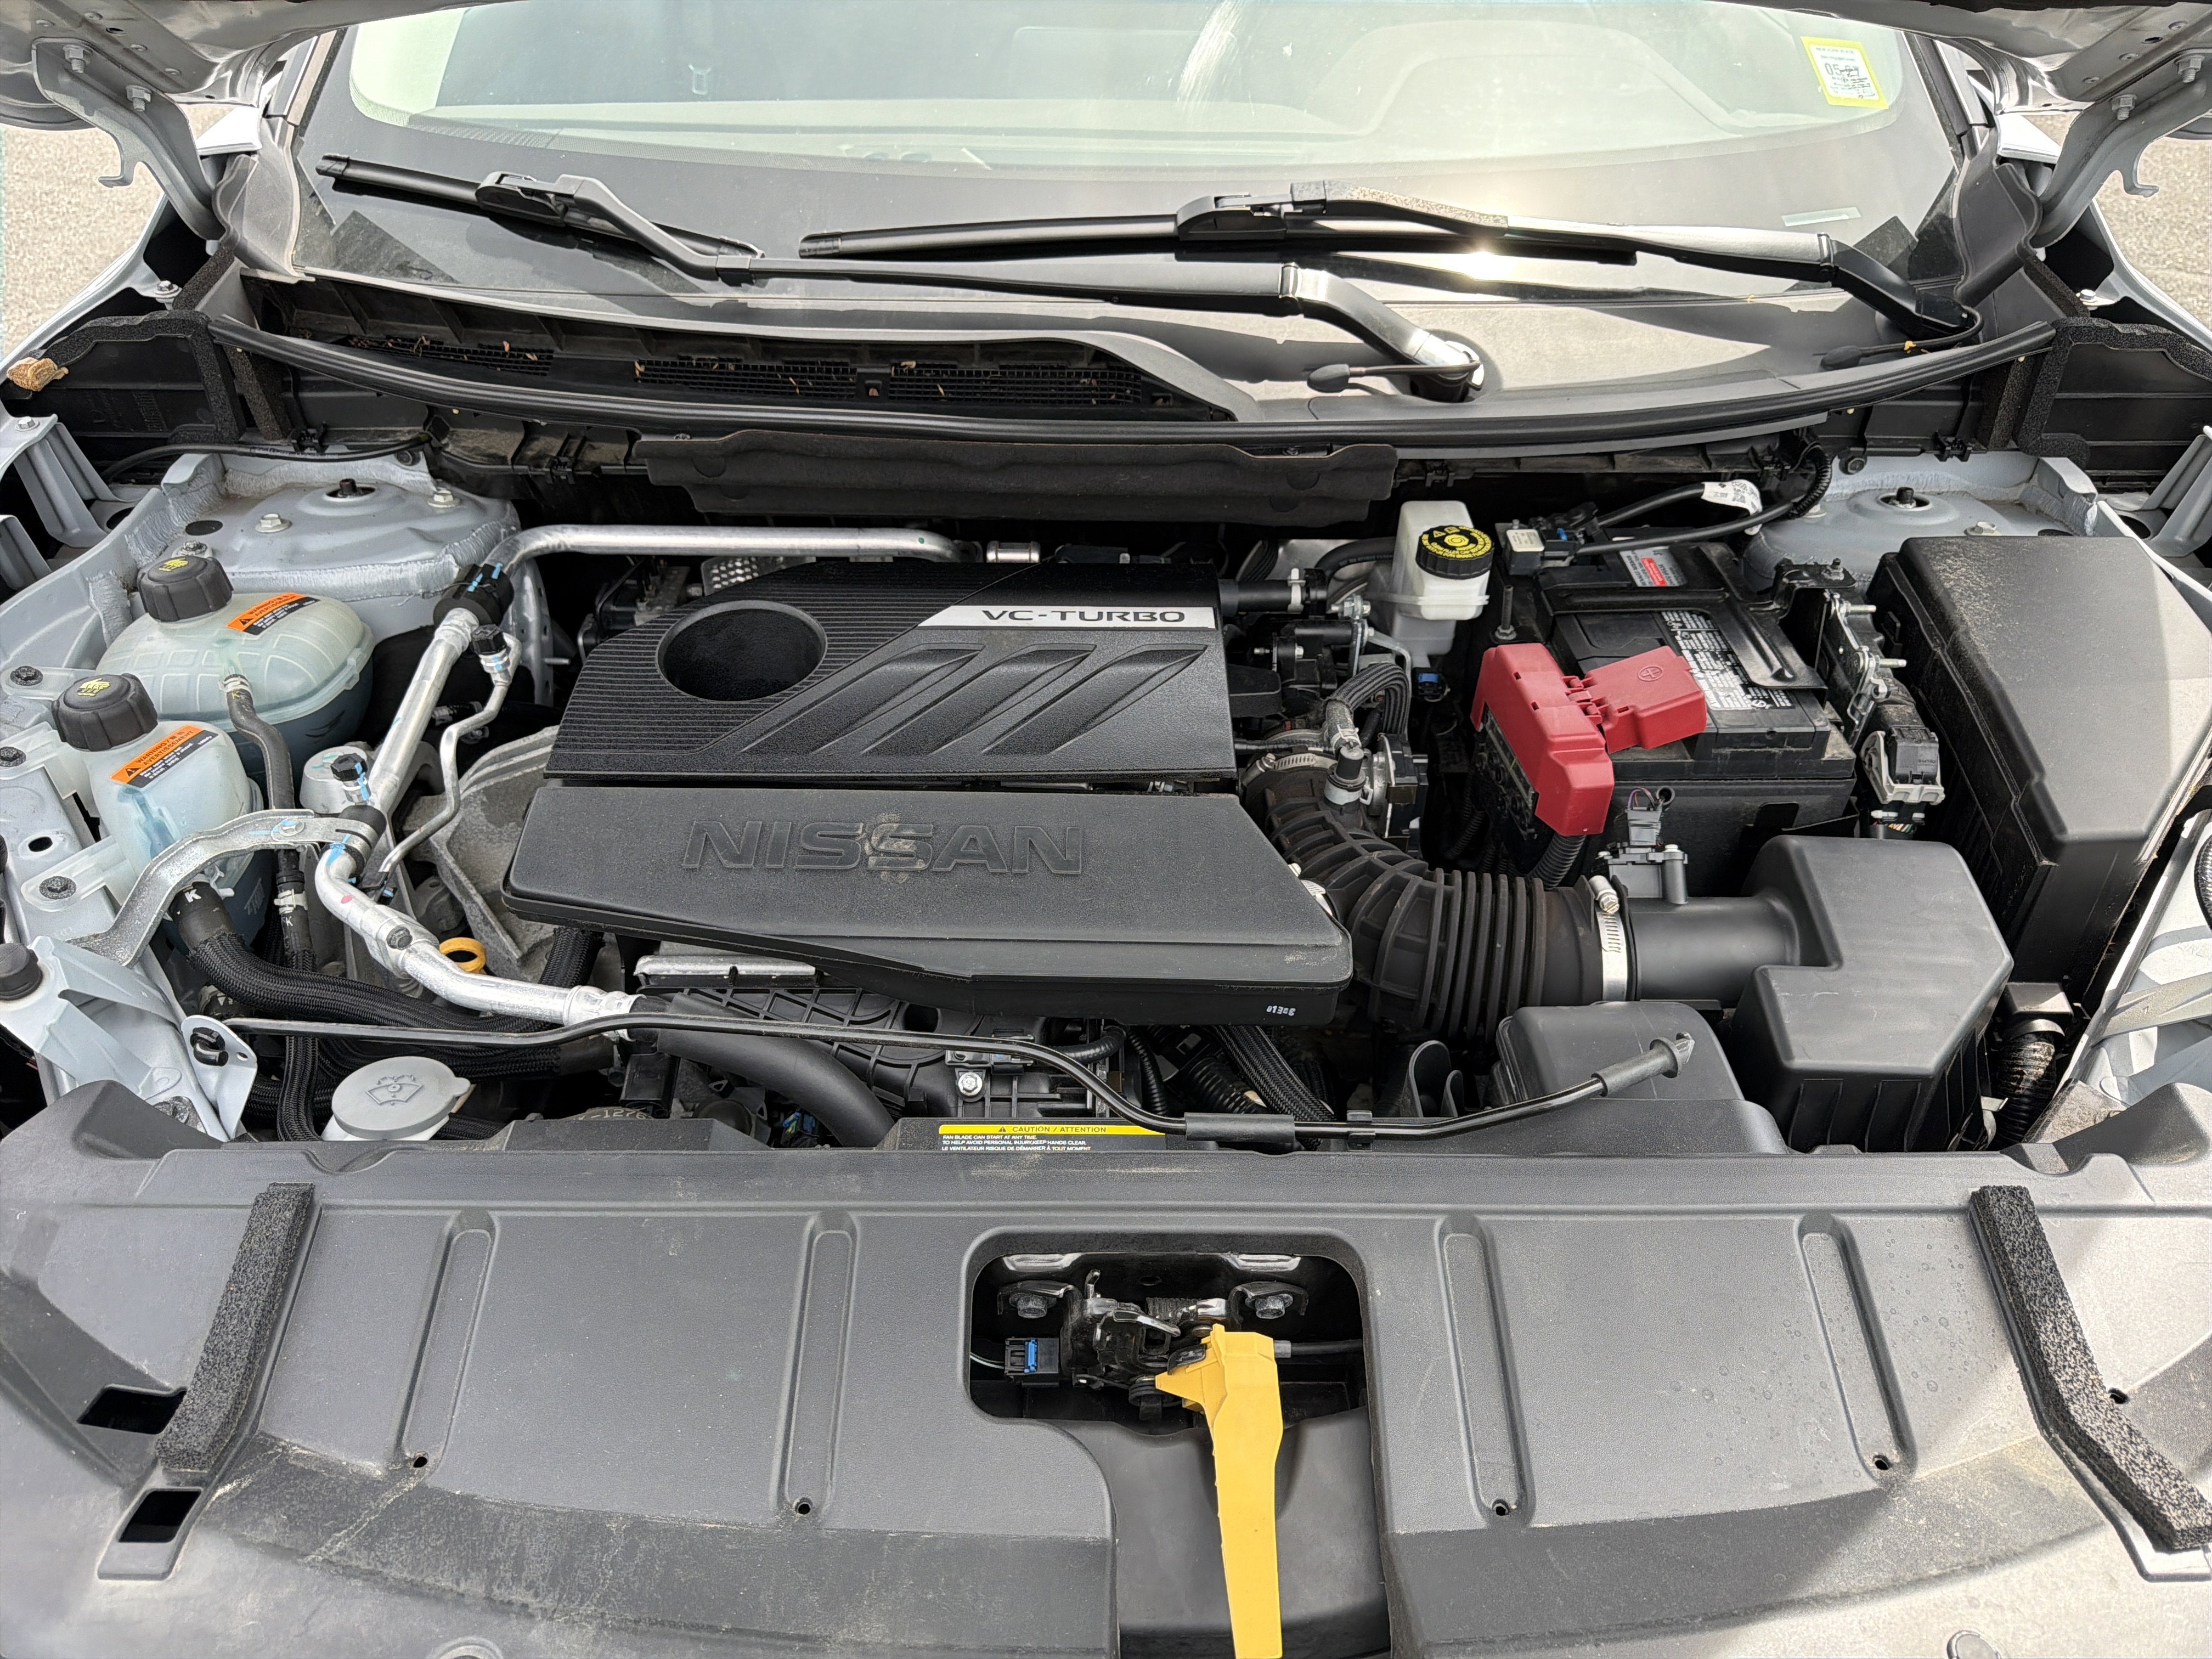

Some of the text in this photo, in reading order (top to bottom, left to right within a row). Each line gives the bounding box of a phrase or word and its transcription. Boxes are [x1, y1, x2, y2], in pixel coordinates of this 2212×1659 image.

[981, 610, 1185, 622] VC-TURBO
[136, 742, 166, 764] WARNING
[144, 730, 194, 766] AVERTISSEMENT
[682, 821, 1082, 874] NISSAN
[184, 889, 202, 903] K
[286, 916, 294, 927] K
